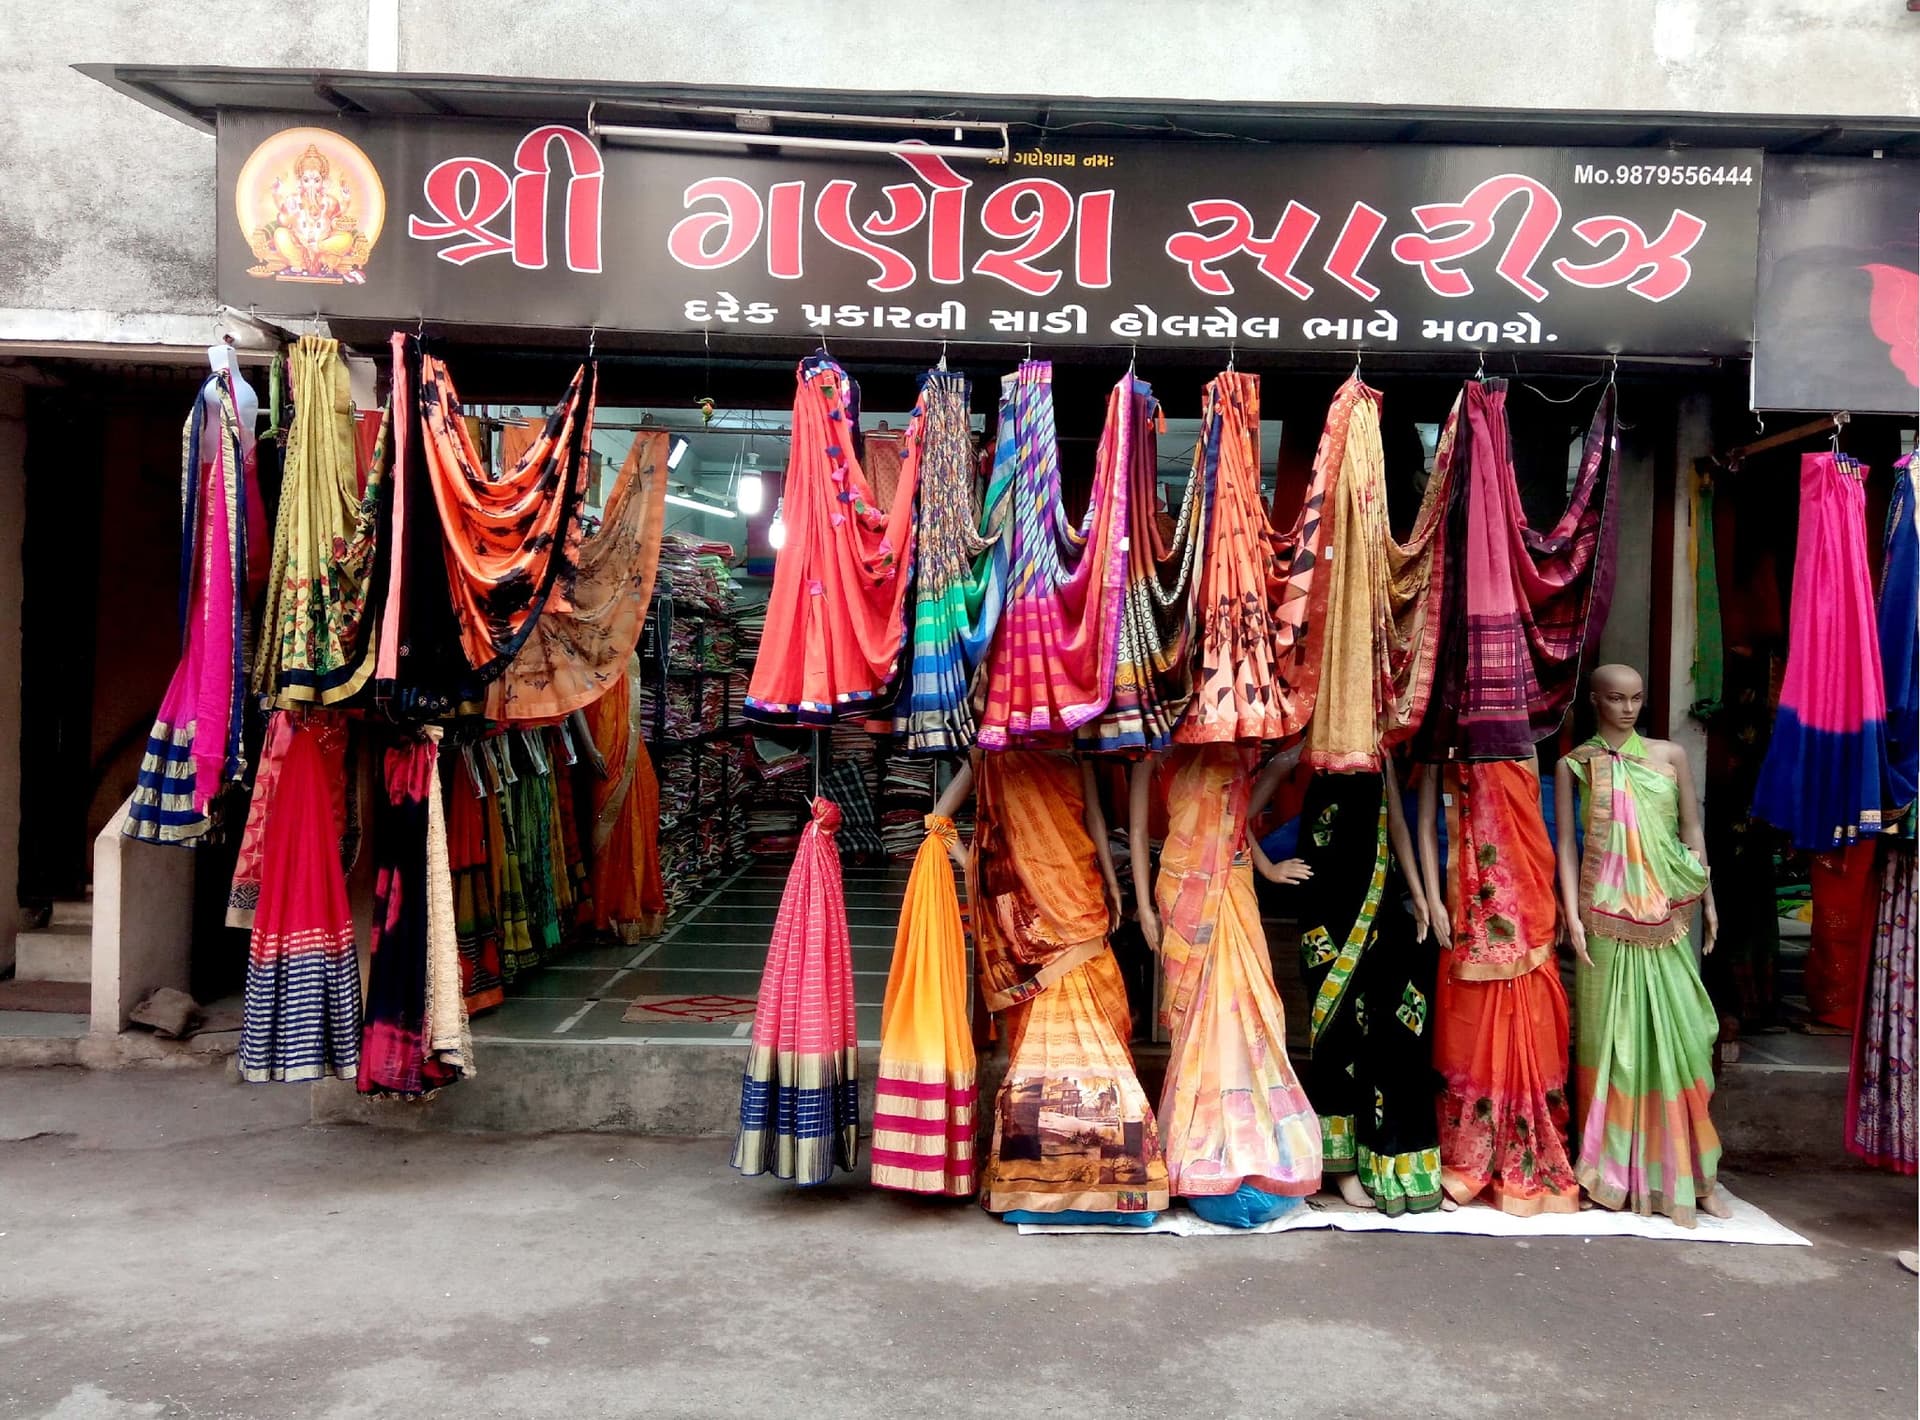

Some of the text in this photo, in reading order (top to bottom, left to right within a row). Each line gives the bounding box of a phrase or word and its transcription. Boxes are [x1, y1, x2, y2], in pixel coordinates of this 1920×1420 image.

[1013, 147, 1076, 167] ગણેશાય
[1574, 164, 1753, 186] Mo.9879556444
[408, 124, 1707, 303] શ્રી ગણેશ સારીઝ
[684, 291, 1558, 344] દરેક પ્રકારની સાડી હોલસેલ ભાવે મળશે.
